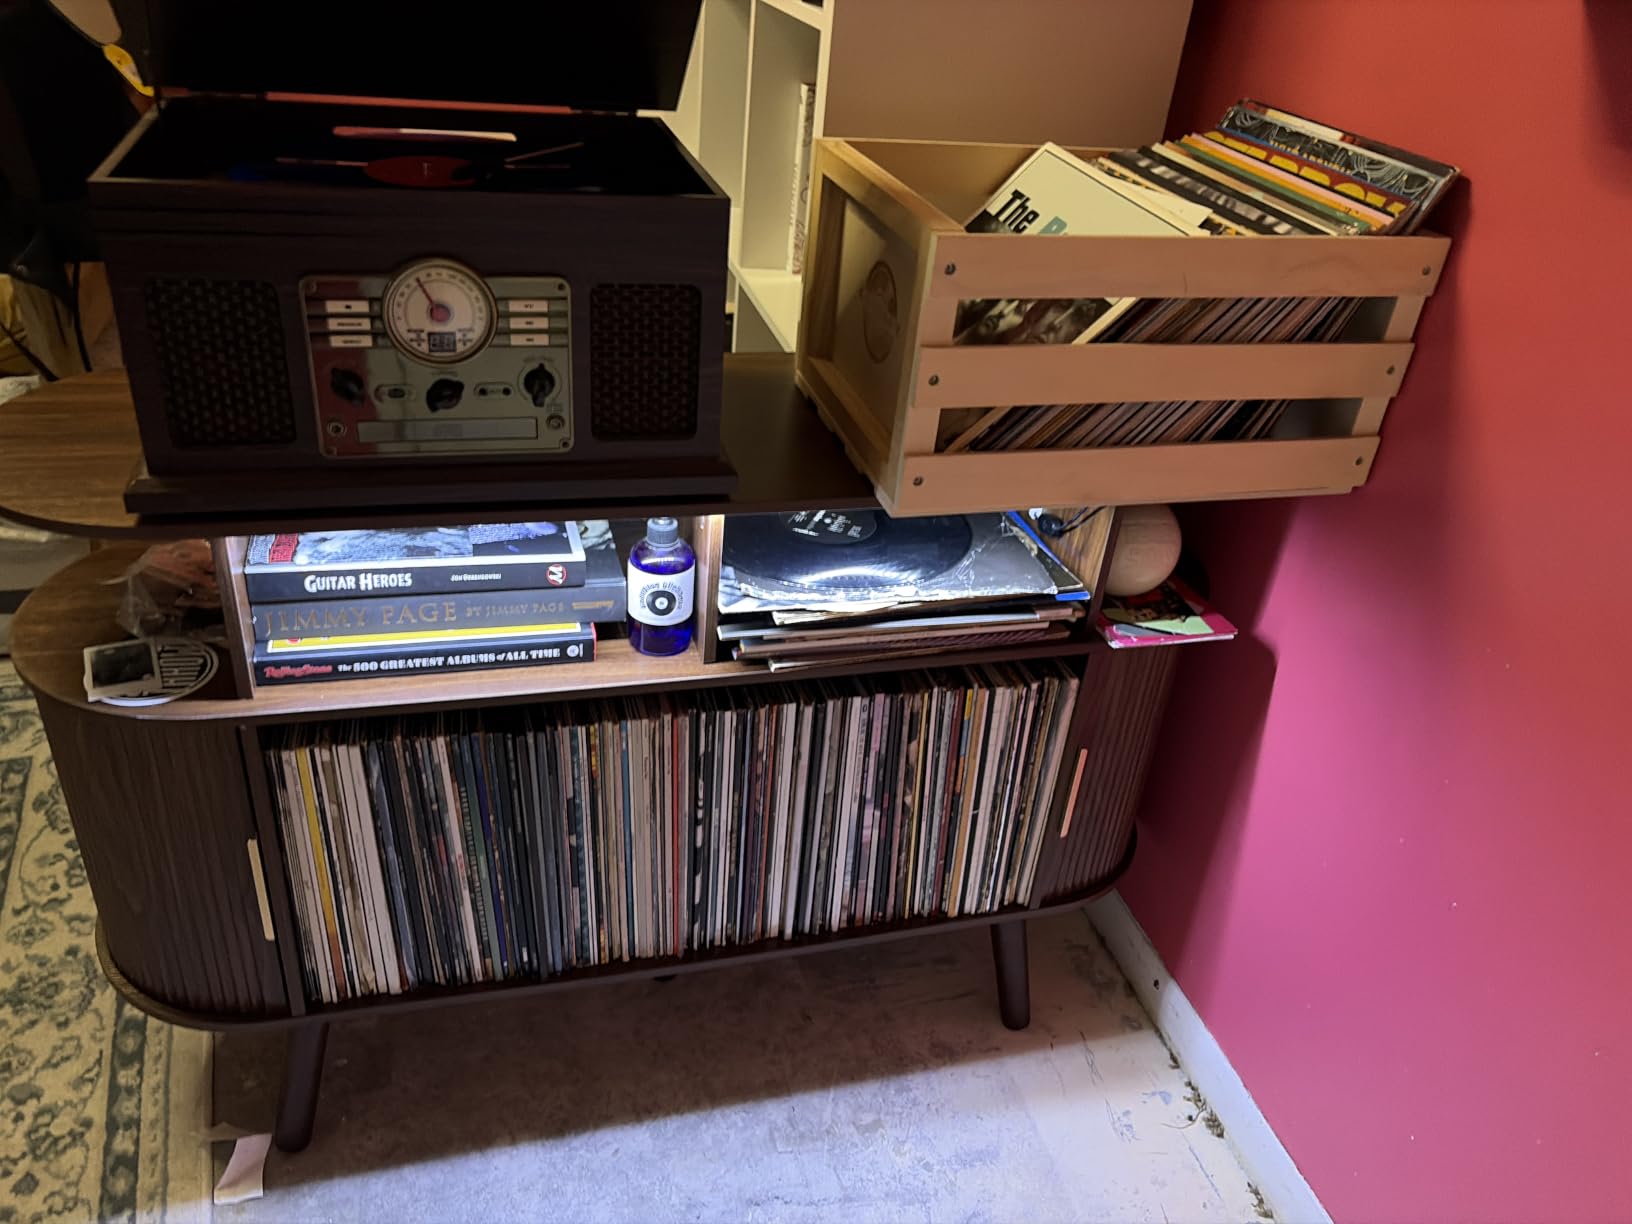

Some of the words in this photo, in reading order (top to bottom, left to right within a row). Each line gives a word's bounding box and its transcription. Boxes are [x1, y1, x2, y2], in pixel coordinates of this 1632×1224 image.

[994, 189, 1040, 234] The
[304, 575, 356, 593] GUITAR
[359, 573, 412, 590] HEROES
[266, 606, 369, 636] JIMMY
[382, 602, 457, 624] PAGE
[466, 607, 482, 616] BY
[353, 661, 378, 672] 500
[380, 657, 445, 670] GREATEST
[447, 653, 496, 665] ALBUMS
[505, 650, 528, 661] ALL
[529, 648, 561, 659] TIME
